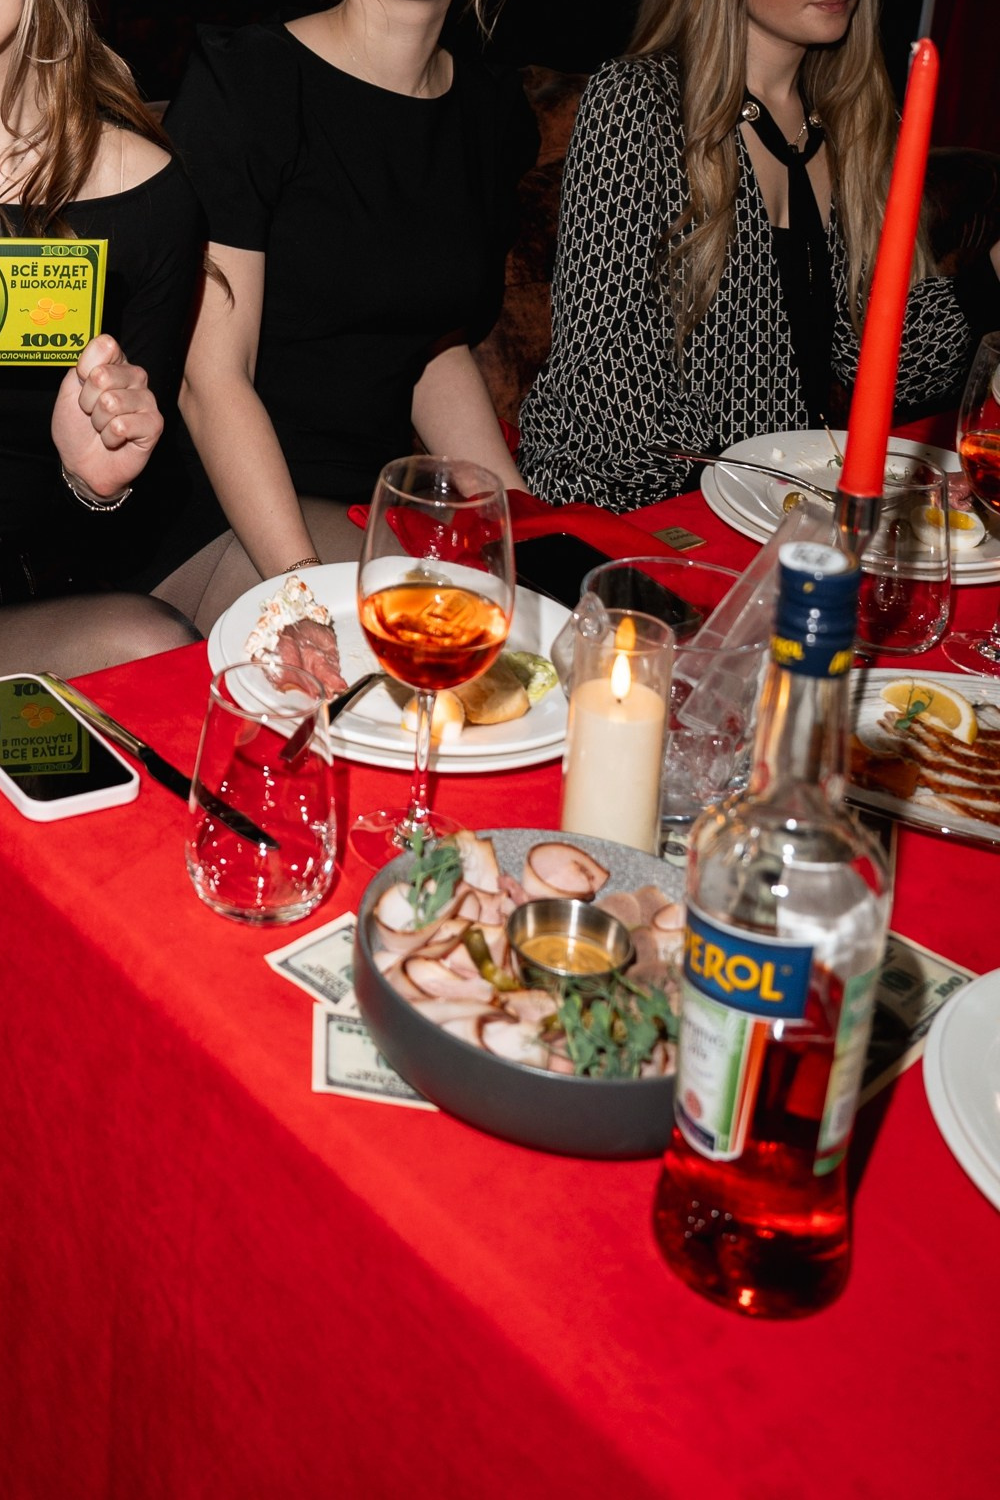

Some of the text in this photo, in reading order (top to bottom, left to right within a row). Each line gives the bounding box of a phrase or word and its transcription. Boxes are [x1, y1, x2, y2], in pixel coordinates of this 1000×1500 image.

[41, 245, 89, 256] 100
[11, 262, 88, 279] ВСЁ БУДЕТ
[10, 279, 88, 290] В ШОКОЛАДЕ
[934, 975, 964, 998] 100
